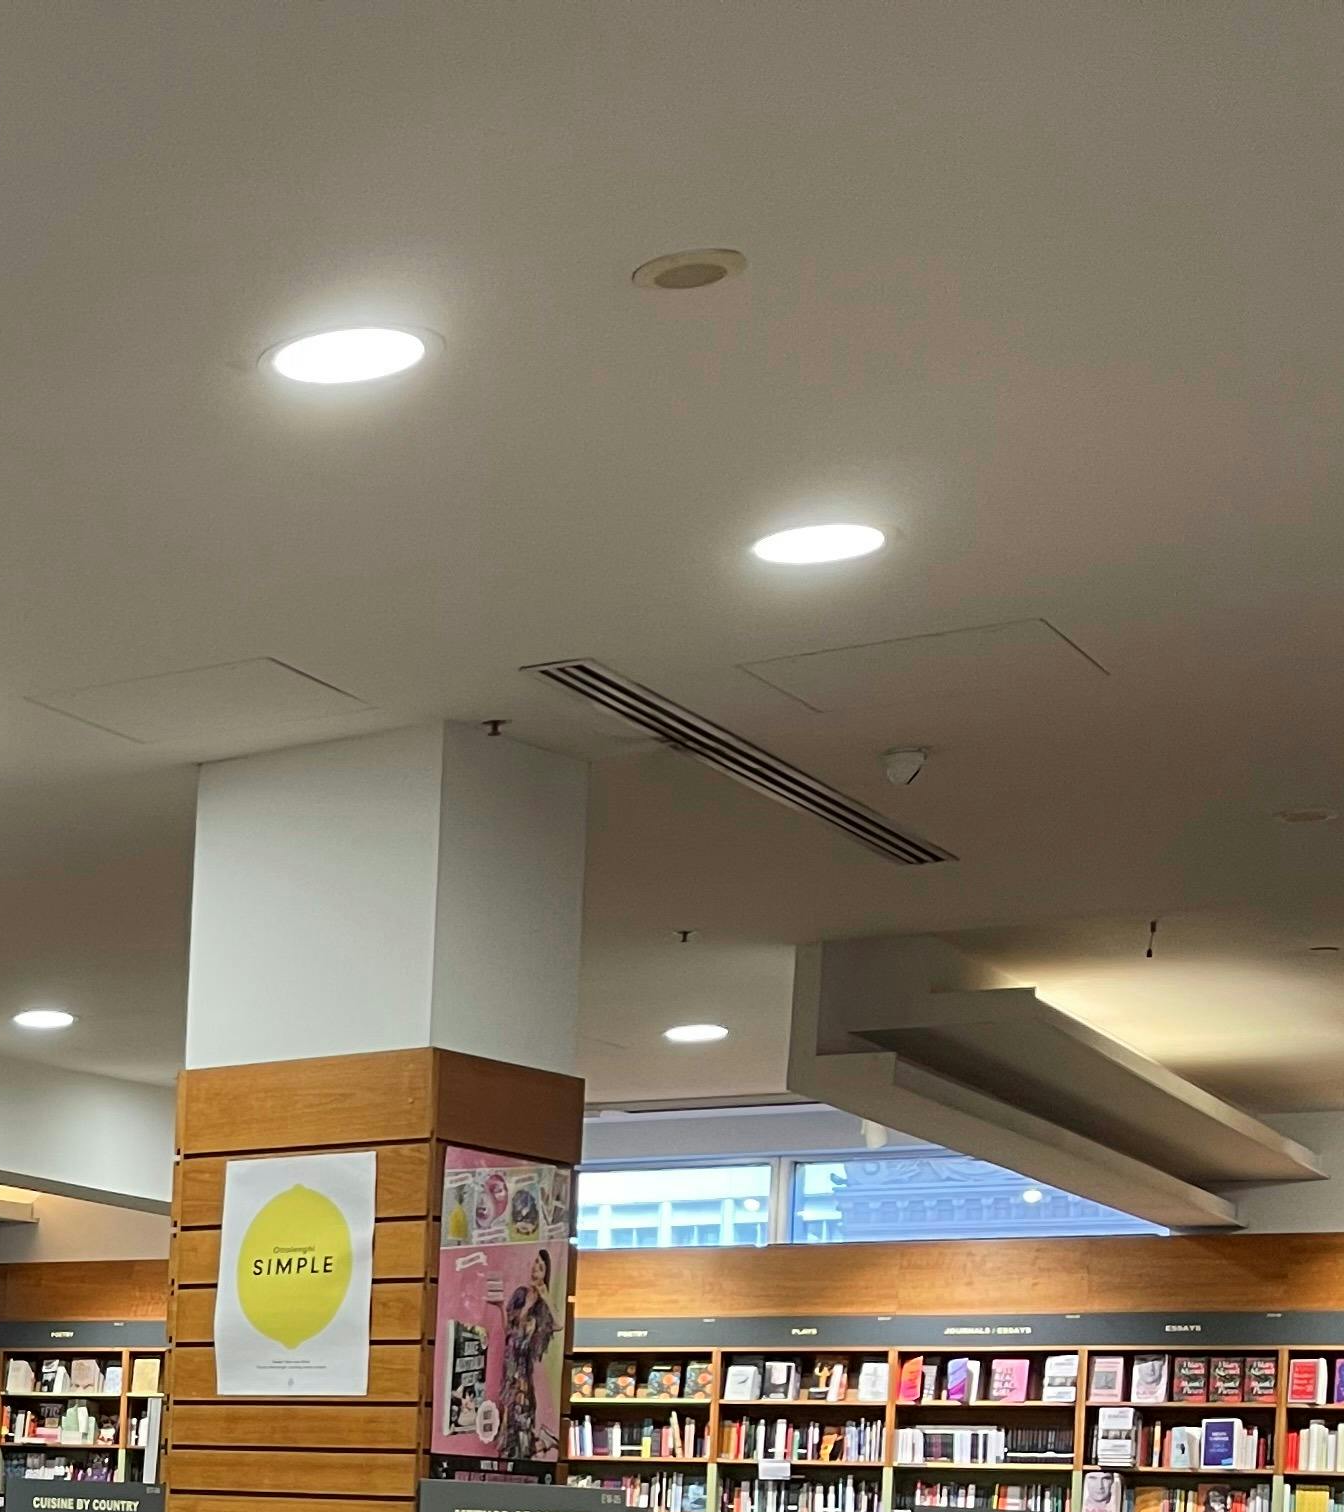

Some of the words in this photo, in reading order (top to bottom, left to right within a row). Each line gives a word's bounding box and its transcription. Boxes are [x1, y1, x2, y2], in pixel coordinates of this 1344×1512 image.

[252, 1255, 334, 1277] SIMPLE
[32, 1497, 74, 1509] CUISINE
[76, 1499, 90, 1510] BY
[92, 1500, 139, 1512] COUNTRY
